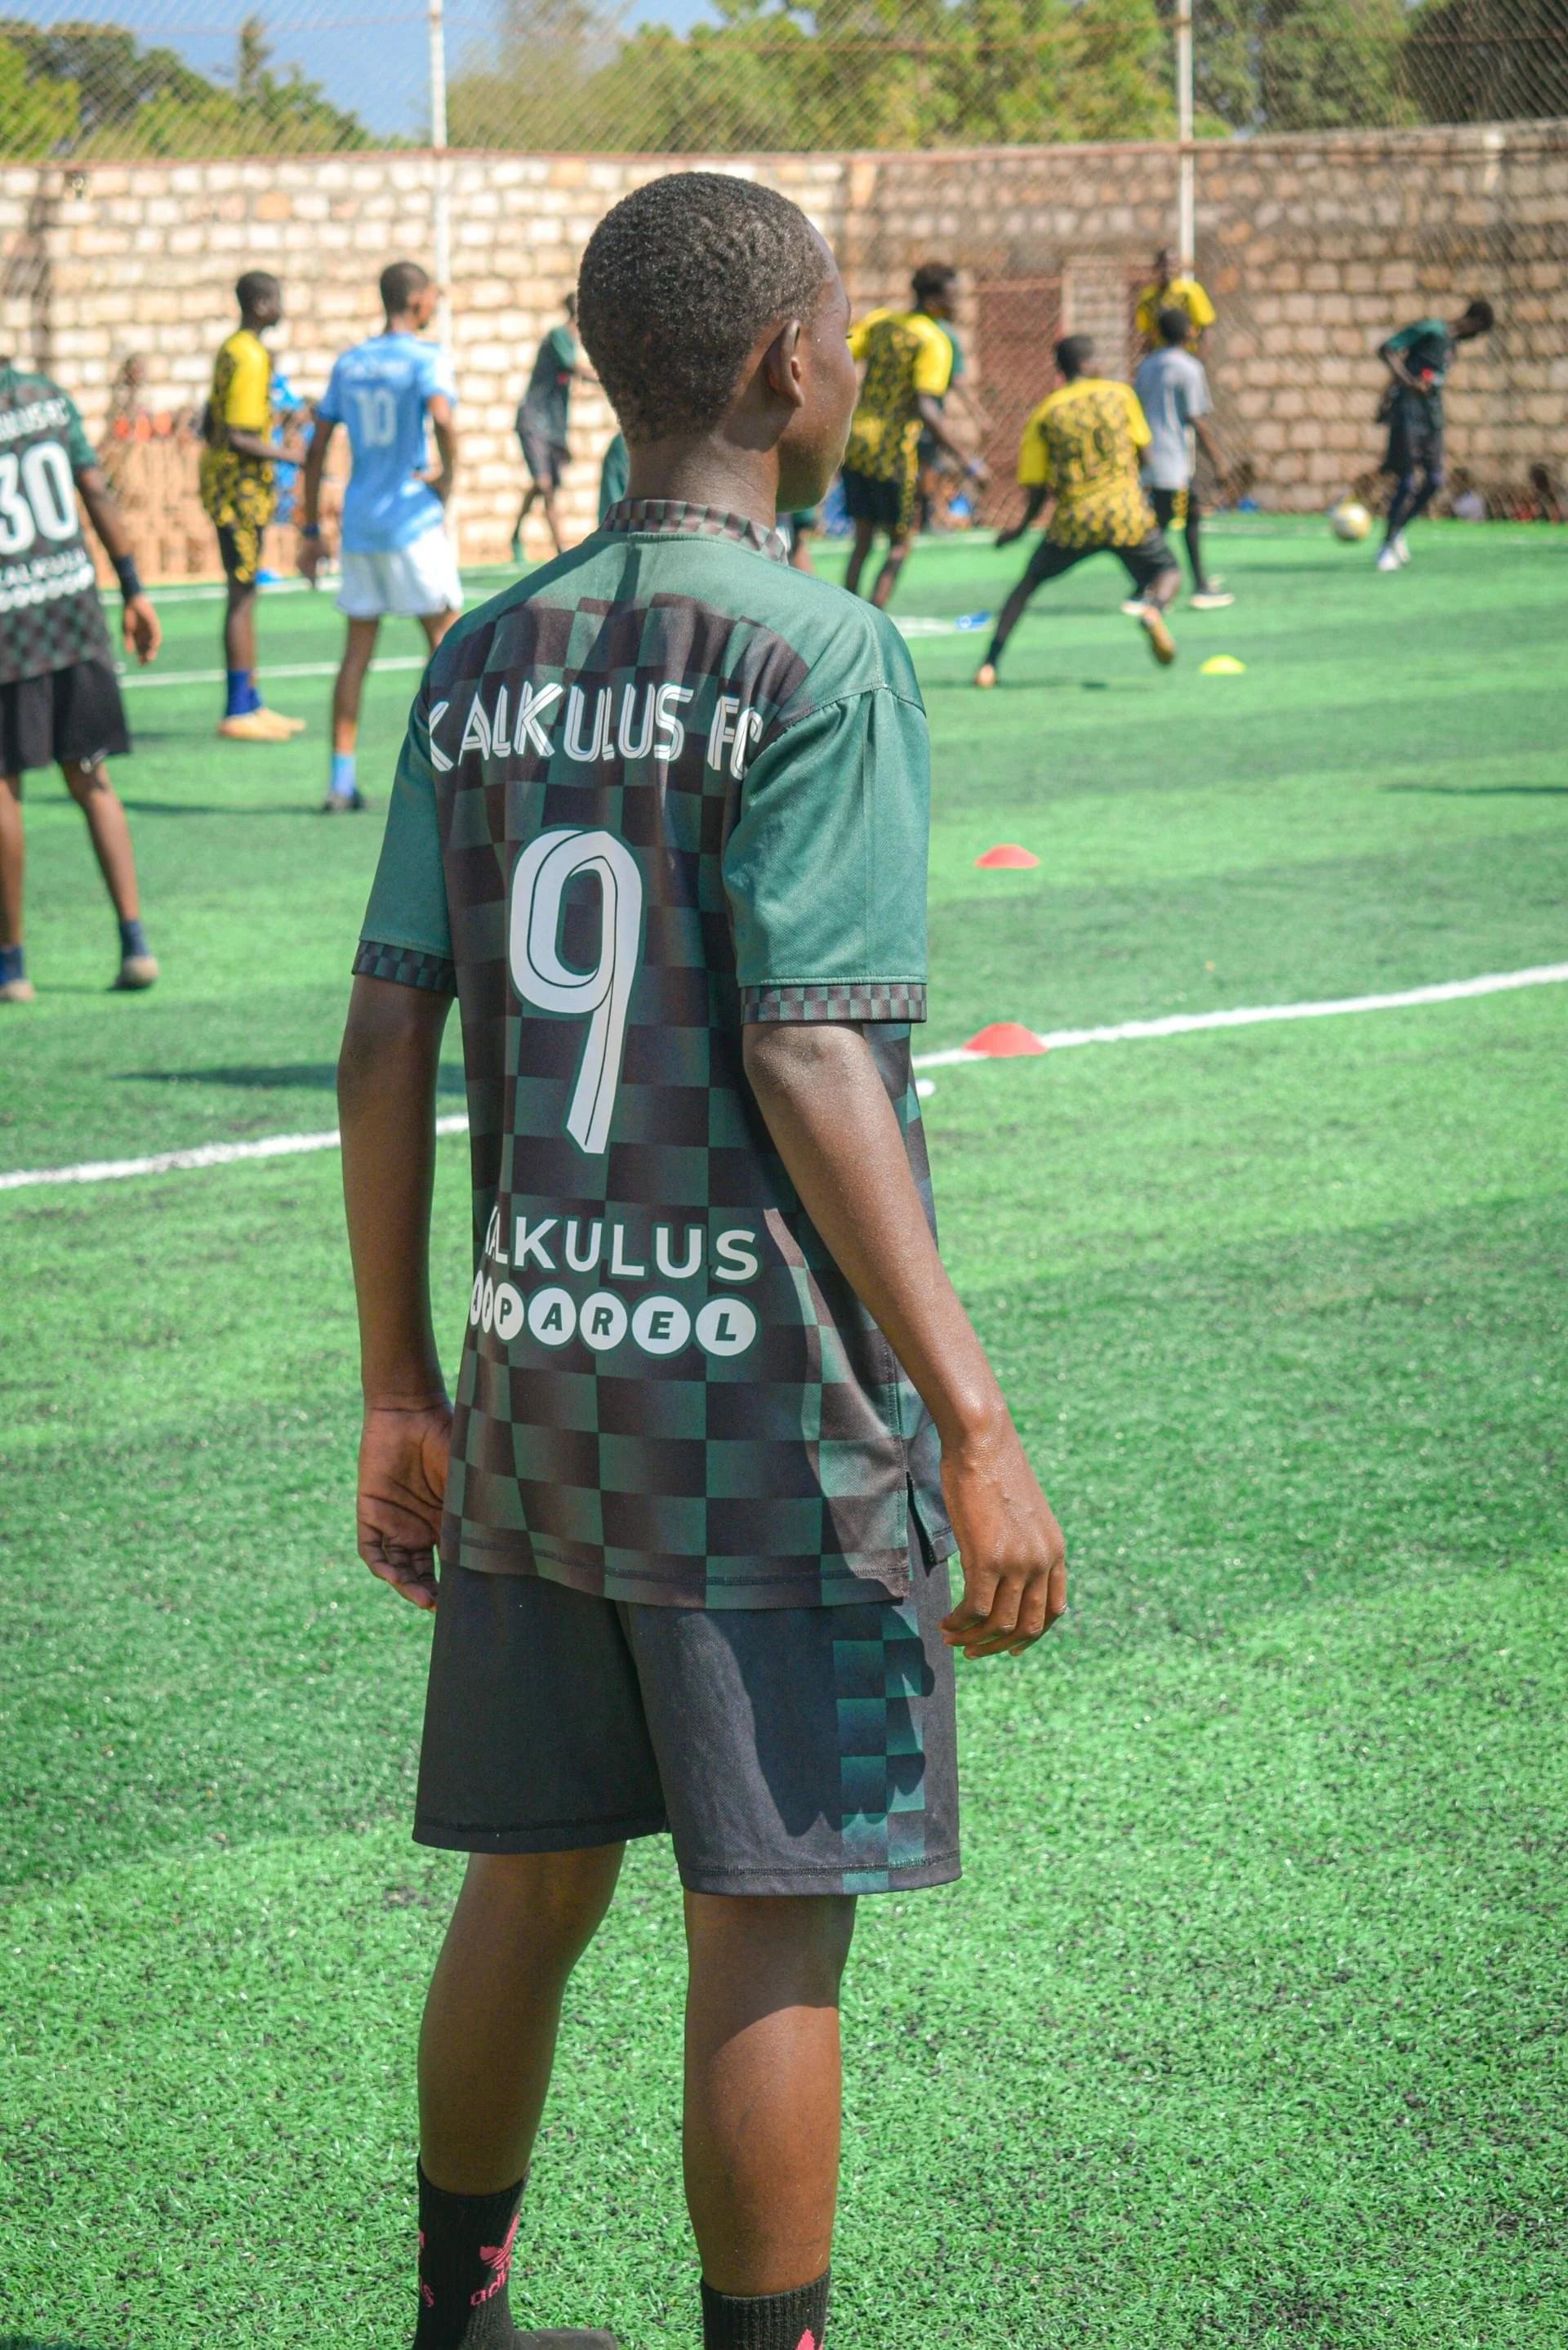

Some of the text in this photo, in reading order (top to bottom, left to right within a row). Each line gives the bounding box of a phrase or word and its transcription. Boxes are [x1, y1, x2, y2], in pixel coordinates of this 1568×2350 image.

[354, 387, 399, 448] 10
[0, 440, 78, 555] 30
[706, 695, 764, 781] FC
[509, 829, 643, 1154] 9
